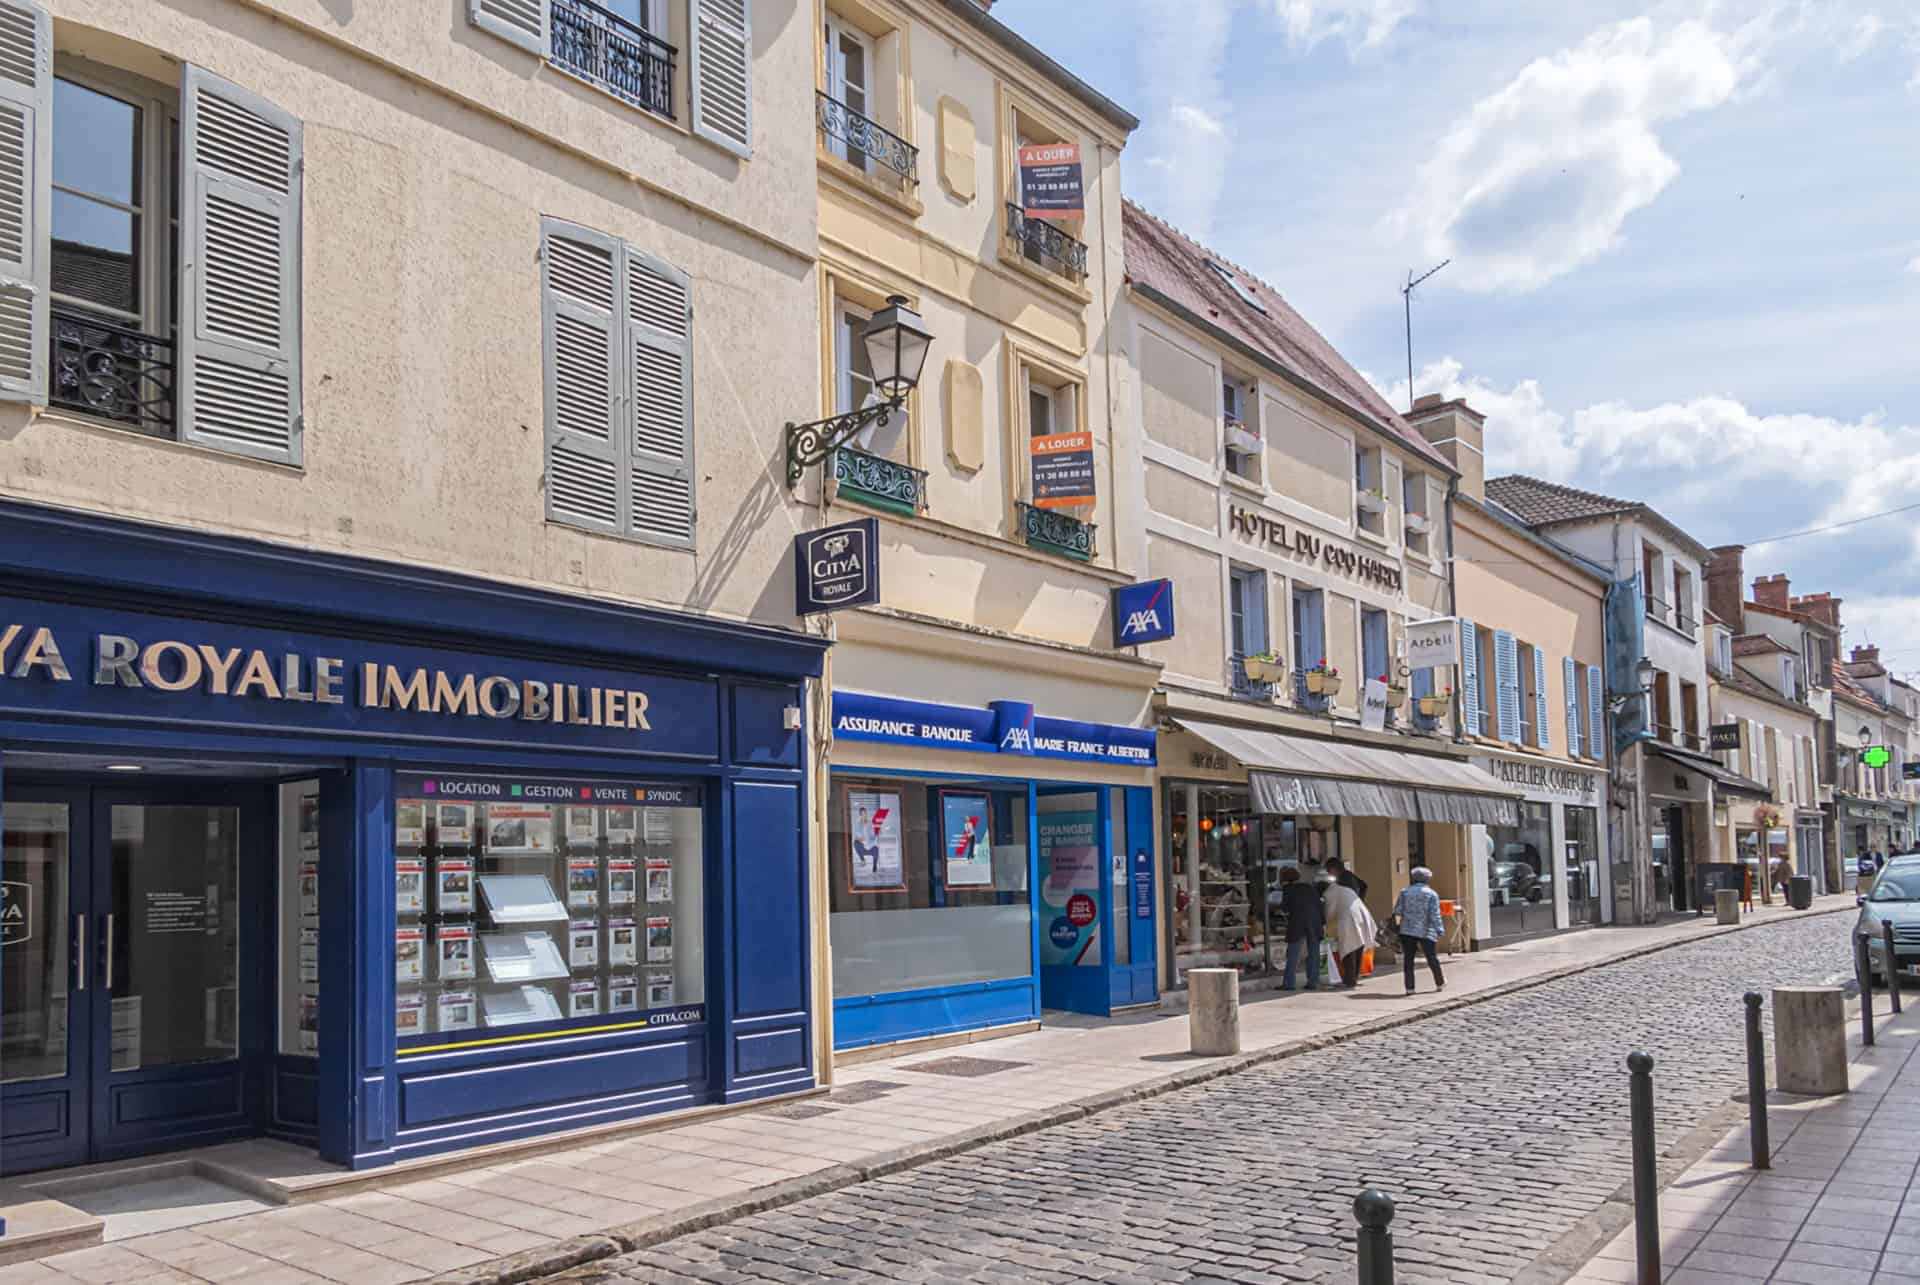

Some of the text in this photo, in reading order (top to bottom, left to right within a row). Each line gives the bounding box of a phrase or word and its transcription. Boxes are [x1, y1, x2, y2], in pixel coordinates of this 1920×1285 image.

[1047, 438, 1085, 449] LOUER
[1228, 504, 1296, 551] HOTEL
[1295, 529, 1320, 560] DU
[1323, 543, 1356, 574] COQ
[1121, 609, 1162, 637] AXA
[94, 633, 344, 704] ROYALE
[361, 660, 652, 731] IMMOBILIER
[837, 716, 973, 743] ASSURANCE BANQUE
[1000, 727, 1032, 750] AXA
[1034, 738, 1065, 753] MARIE
[1067, 741, 1104, 756] FRANCE
[439, 782, 682, 802] LOCATION GESTION VENTE SYNDIC
[649, 1009, 701, 1025] CITYA.COM
